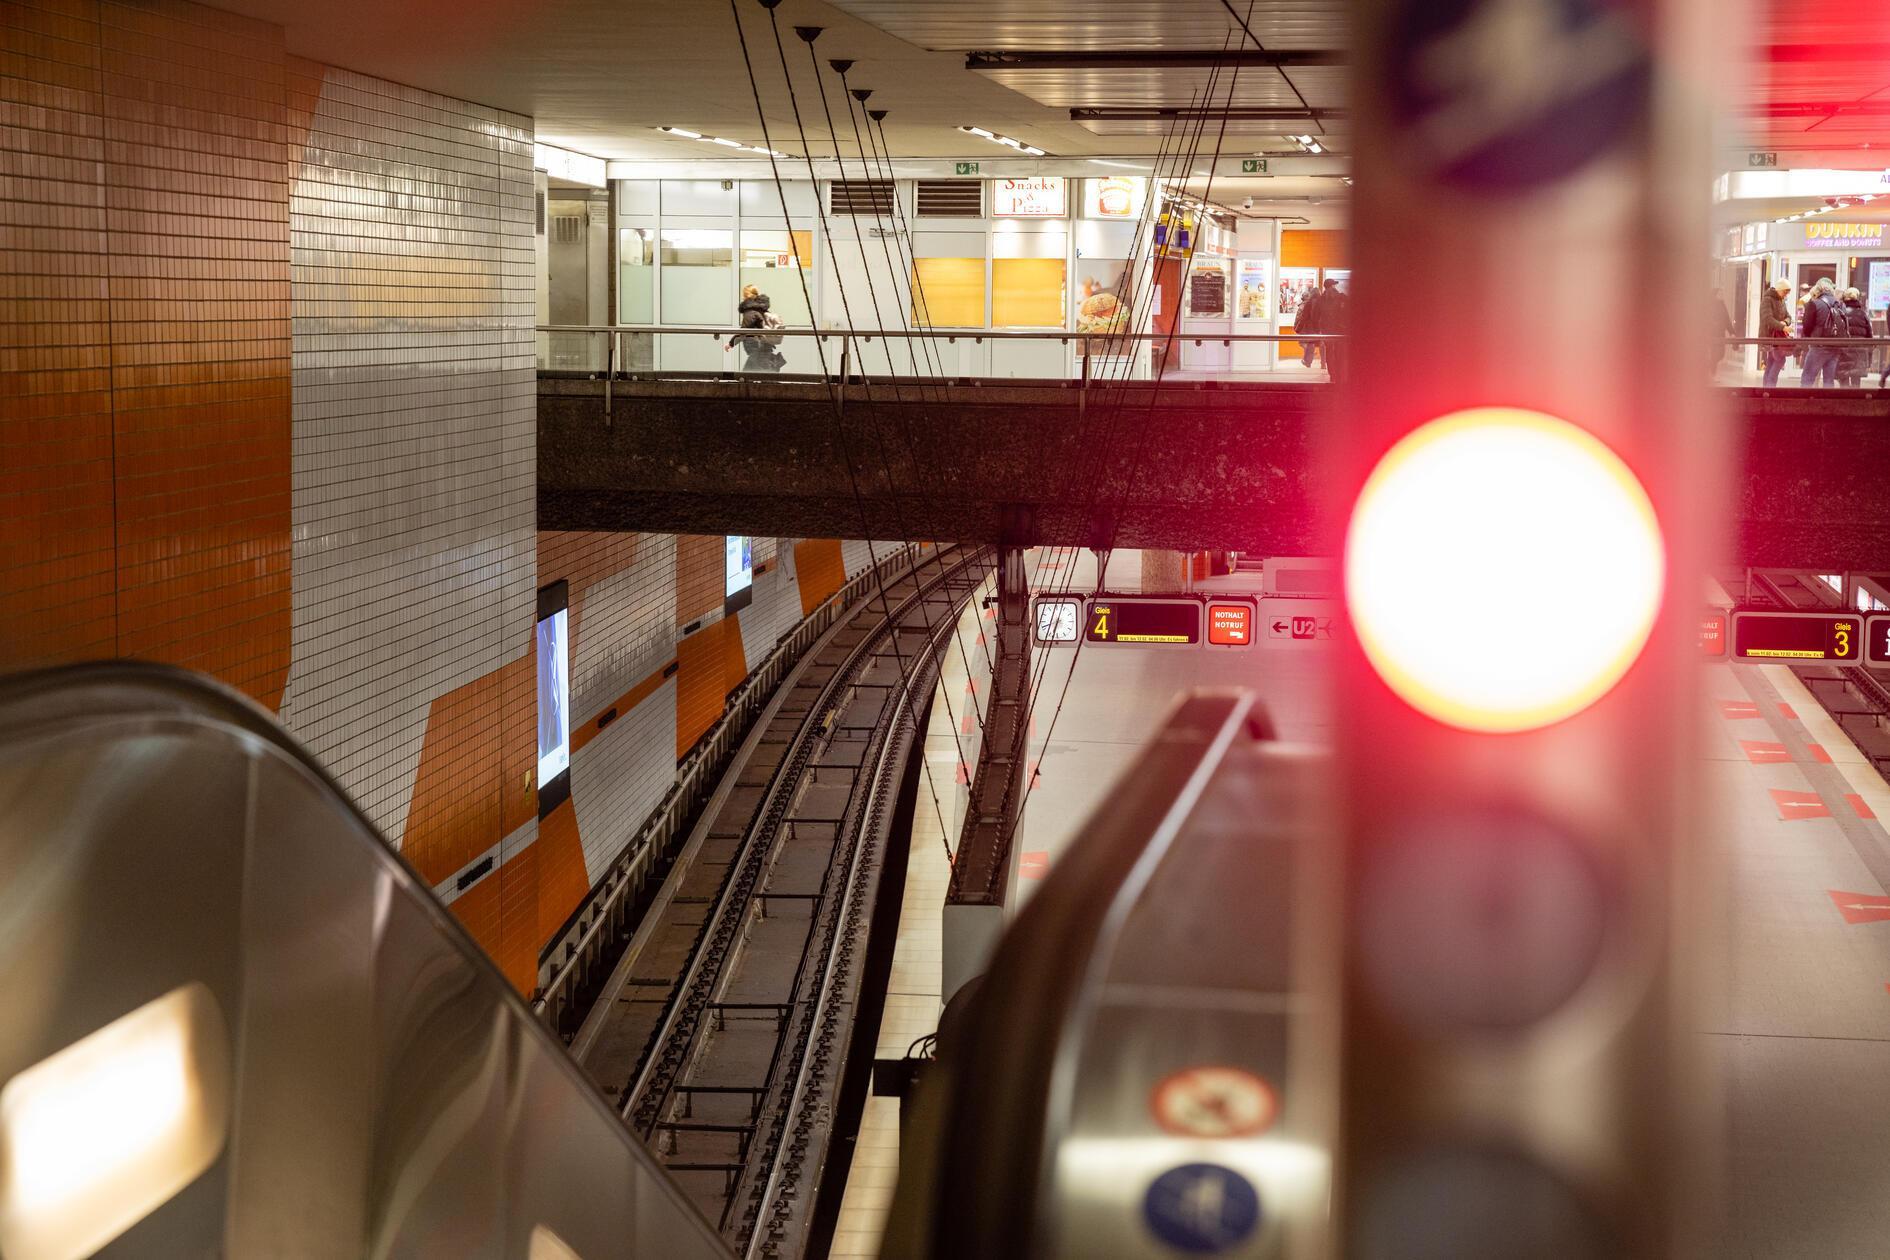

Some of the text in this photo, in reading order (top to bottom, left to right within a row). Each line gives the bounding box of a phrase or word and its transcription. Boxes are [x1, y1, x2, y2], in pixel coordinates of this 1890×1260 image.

[1004, 178, 1055, 191] Snacks
[1012, 198, 1048, 213] Pizza
[1095, 606, 1111, 615] Gleis
[1215, 611, 1244, 619] NOTHALT
[1094, 615, 1109, 639] 4
[1215, 621, 1244, 629] NOTRUF
[1294, 620, 1316, 635] U2
[1834, 622, 1852, 631] Gleis
[1834, 631, 1849, 657] 3
